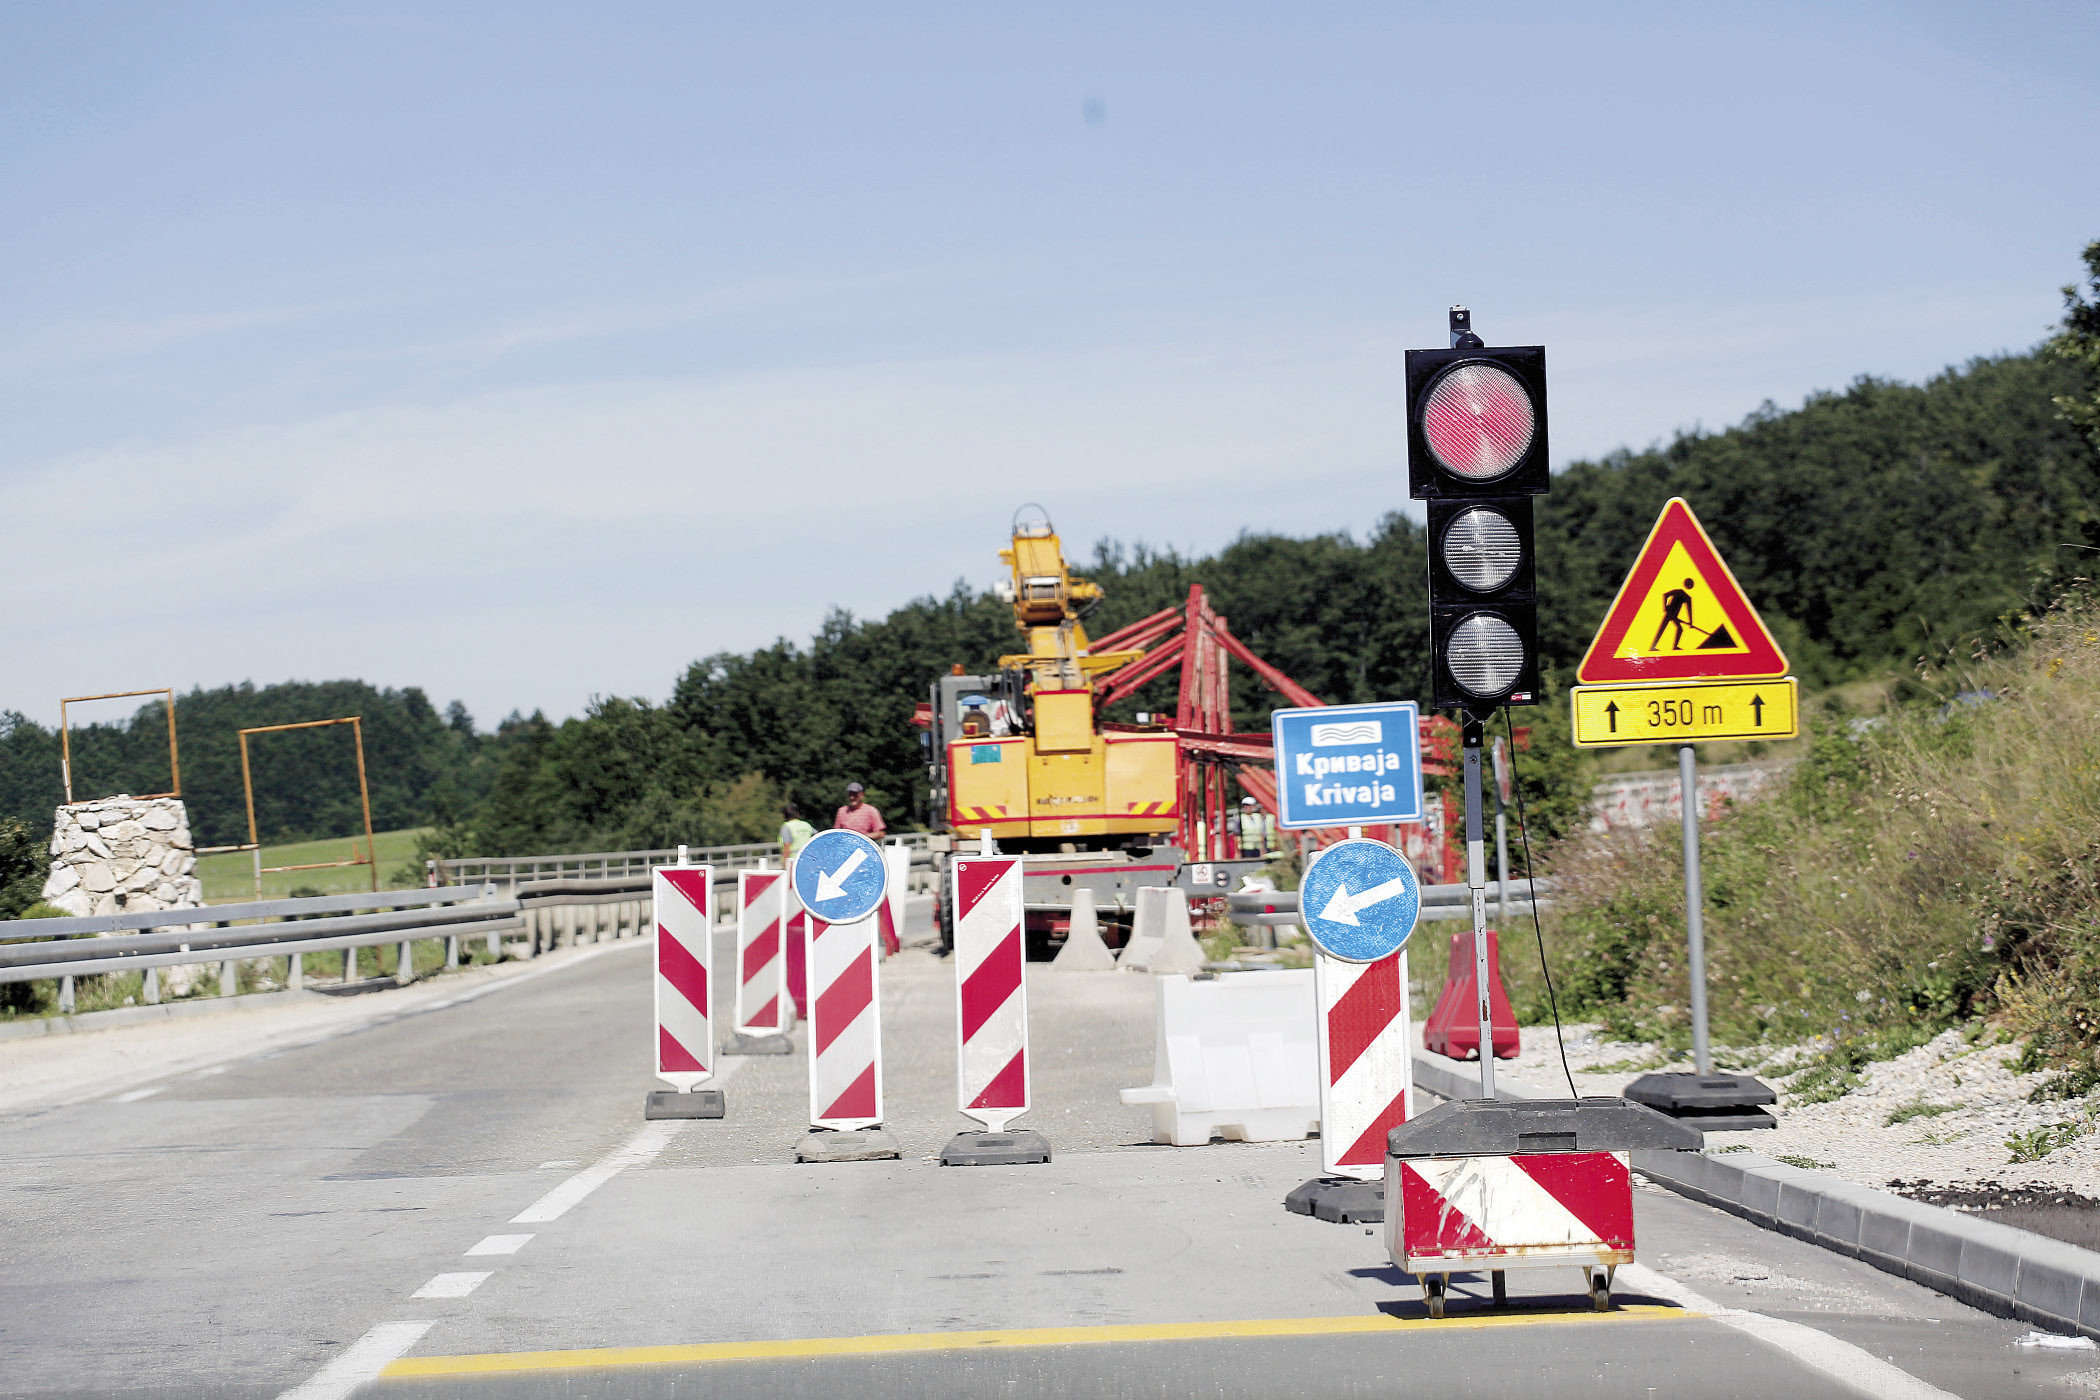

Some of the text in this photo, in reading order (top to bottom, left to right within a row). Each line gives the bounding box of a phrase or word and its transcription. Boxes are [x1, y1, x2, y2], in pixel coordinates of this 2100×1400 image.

[1647, 699, 1723, 727] 350 m
[1296, 748, 1400, 779] Криваја
[1304, 780, 1395, 808] Krivaja
